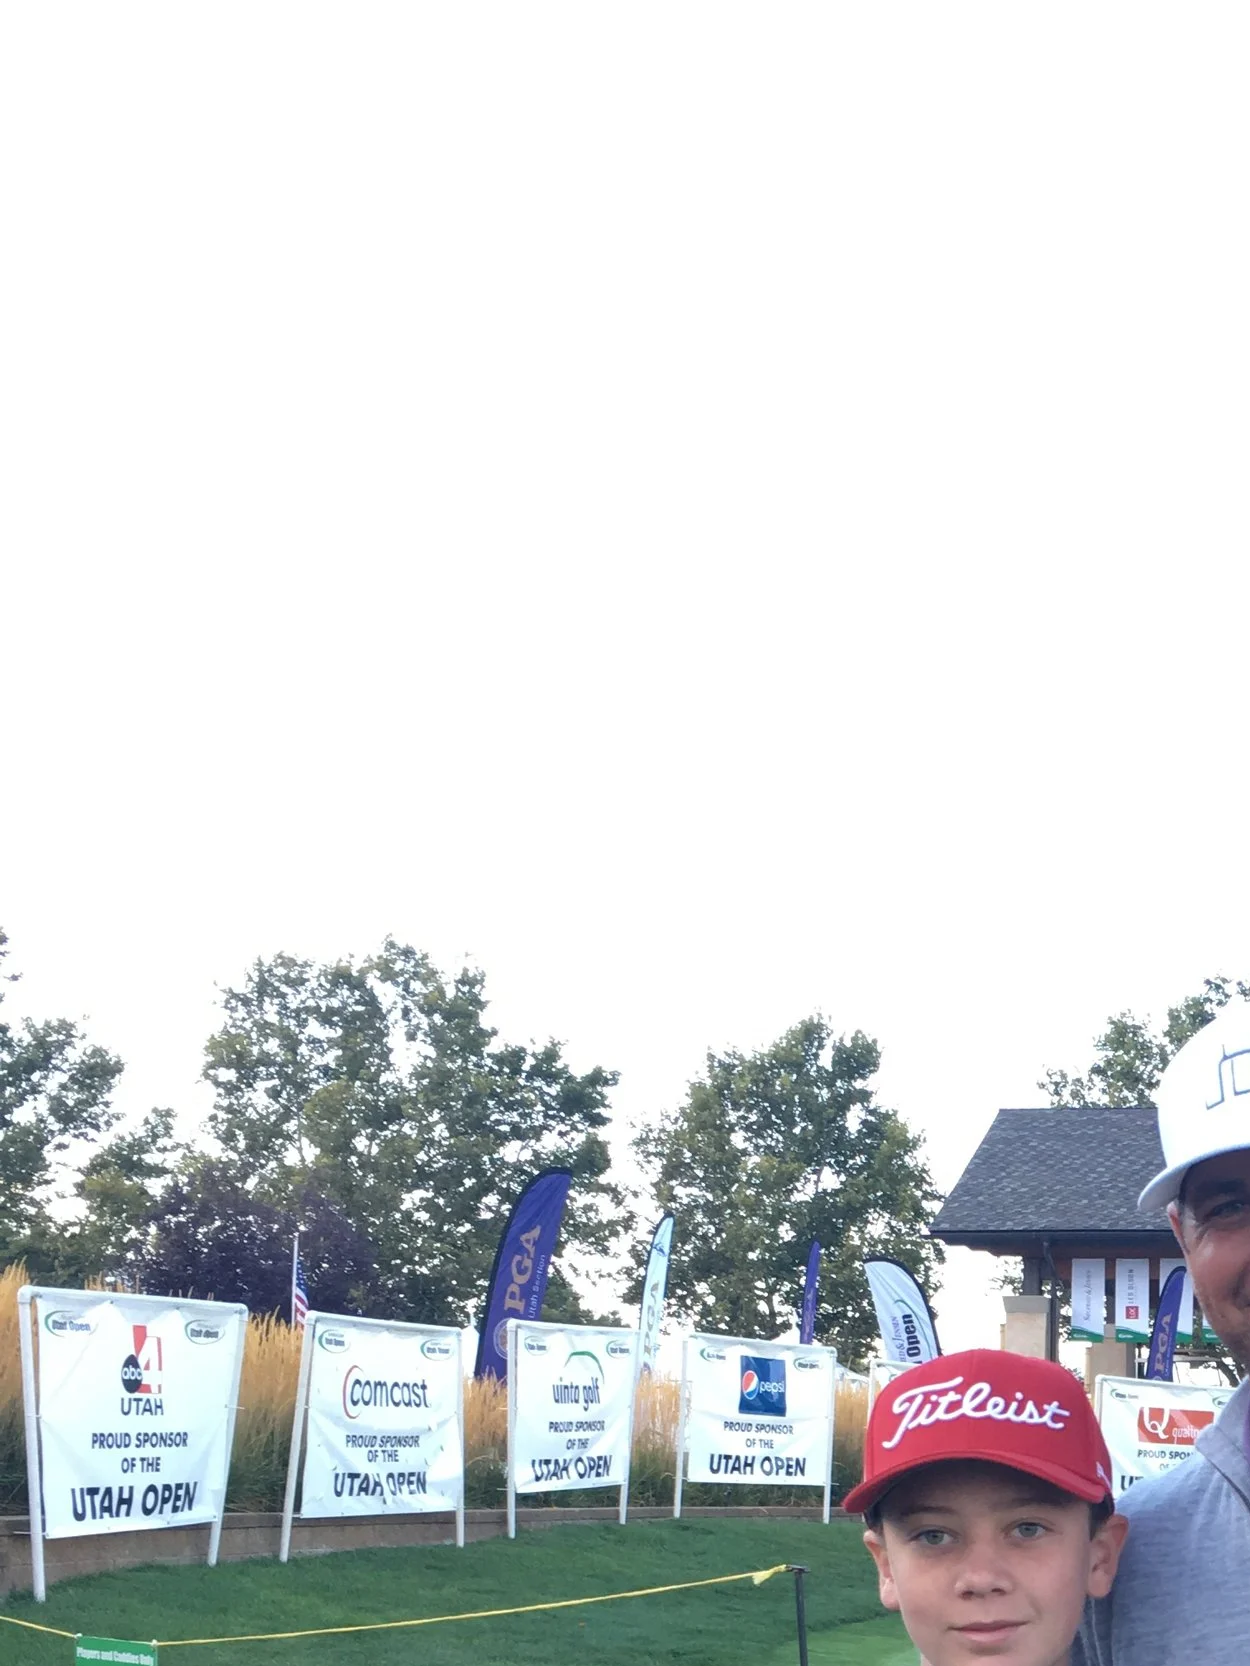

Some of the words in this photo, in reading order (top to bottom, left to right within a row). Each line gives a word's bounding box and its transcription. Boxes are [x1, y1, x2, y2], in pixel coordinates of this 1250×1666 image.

[504, 1225, 541, 1314] PGA
[902, 1314, 921, 1358] Open
[1154, 1313, 1172, 1374] PGA
[121, 1365, 143, 1380] abc
[552, 1376, 580, 1404] uinta
[582, 1376, 601, 1412] golf
[760, 1380, 785, 1393] pepsi
[121, 1397, 164, 1416] UTAH
[881, 1376, 1070, 1449] Titleist
[548, 1421, 574, 1433] PROUD
[574, 1420, 605, 1432] SPONSOR
[723, 1421, 753, 1433] PROUD
[755, 1423, 794, 1435] SPONSOR
[91, 1432, 132, 1449] PROUD
[135, 1431, 189, 1448] SPONSOR
[345, 1434, 377, 1448] PROUD
[379, 1435, 421, 1448] SPONSOR
[566, 1438, 576, 1450] OF
[577, 1438, 590, 1449] THE
[745, 1438, 756, 1448] OF
[758, 1438, 774, 1449] THE
[367, 1449, 379, 1463] OF
[381, 1449, 399, 1463] THE
[1137, 1448, 1167, 1460] PROUD
[121, 1457, 136, 1474] OF
[140, 1456, 161, 1473] THE
[531, 1458, 573, 1482] UTAH
[574, 1454, 613, 1479] OPEN
[709, 1453, 756, 1475] UTAH
[760, 1455, 806, 1477] OPEN
[333, 1472, 385, 1498] UTAH
[386, 1471, 427, 1497] OPEN
[71, 1485, 134, 1522] UTAH
[141, 1481, 198, 1517] OPEN
